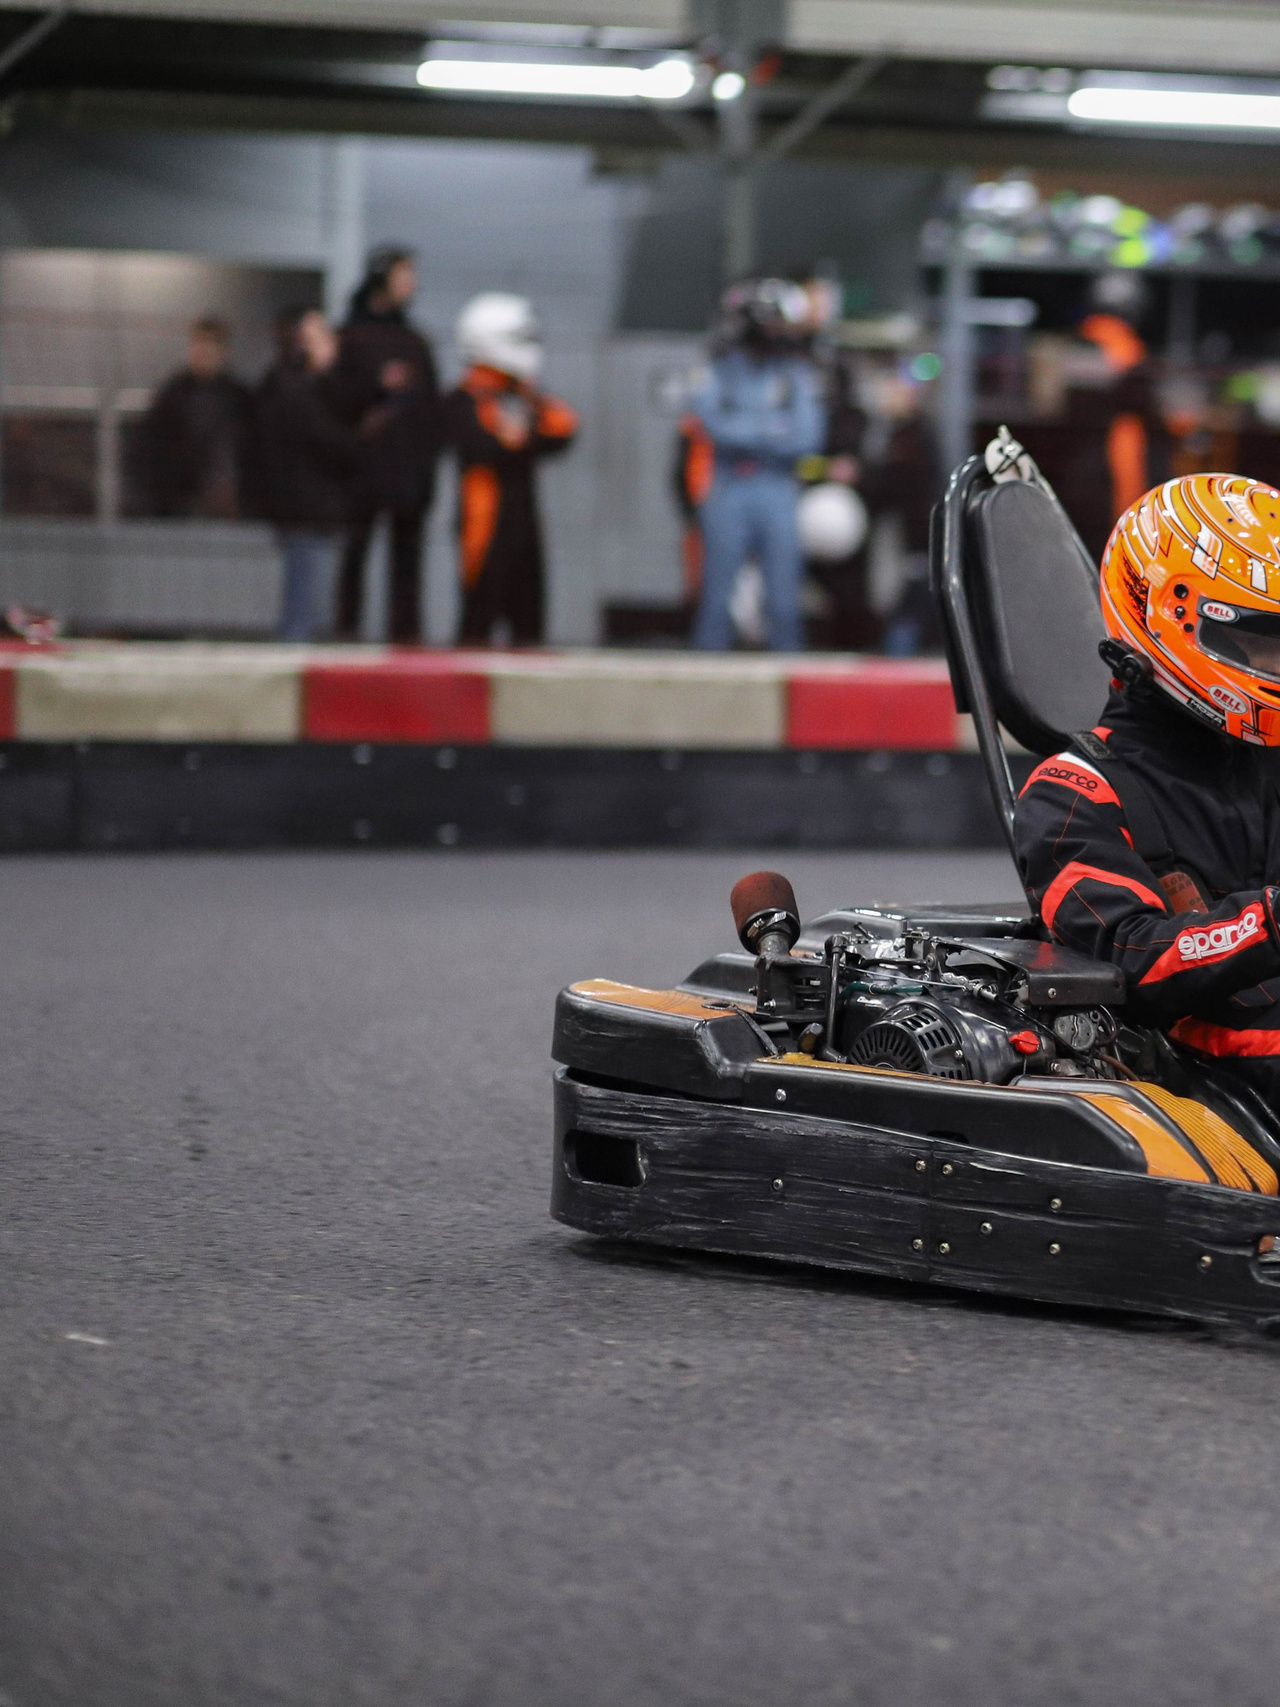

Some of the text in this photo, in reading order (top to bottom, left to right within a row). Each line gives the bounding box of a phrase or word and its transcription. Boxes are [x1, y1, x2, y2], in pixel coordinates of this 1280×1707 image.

[1207, 605, 1231, 618] BELL
[1190, 699, 1222, 724] MOZA
[1213, 688, 1240, 711] BELL
[1036, 767, 1098, 792] sparco
[1178, 911, 1259, 961] sparco
